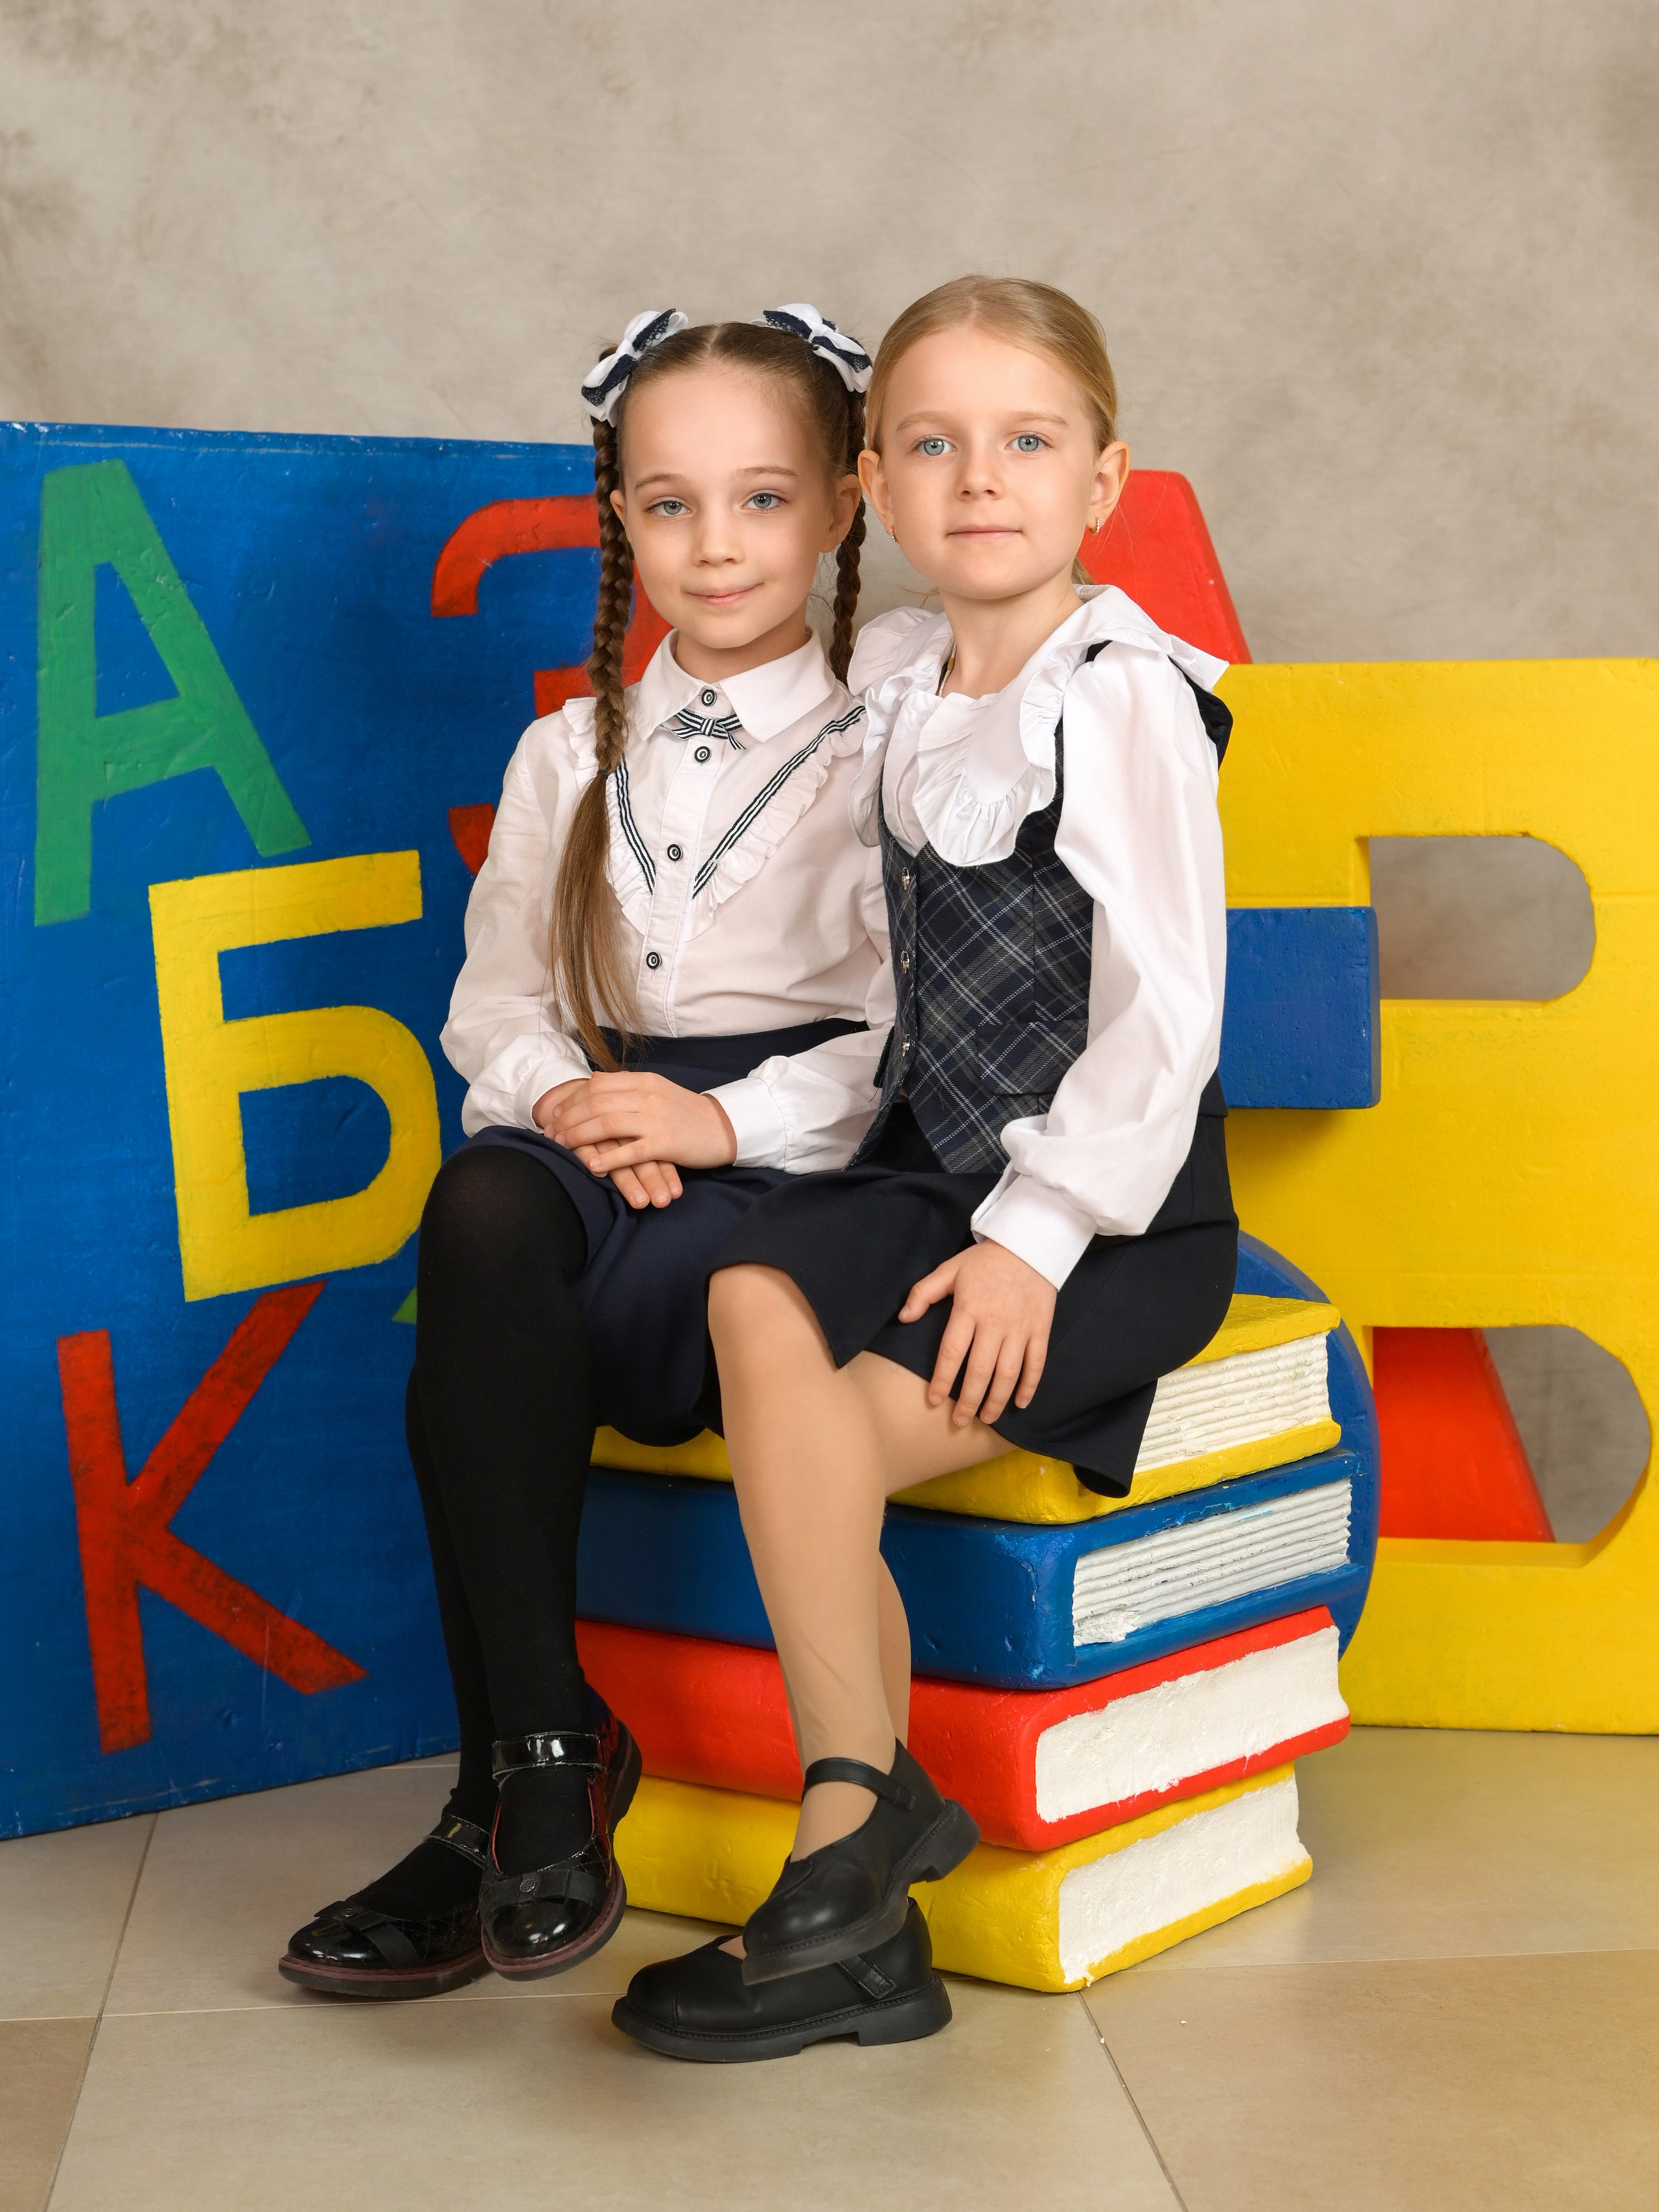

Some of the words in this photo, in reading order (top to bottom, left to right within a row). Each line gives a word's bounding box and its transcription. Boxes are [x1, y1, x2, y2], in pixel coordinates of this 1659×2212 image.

[34, 459, 310, 927] А
[148, 849, 442, 1302] Б
[56, 1281, 367, 1755] К
